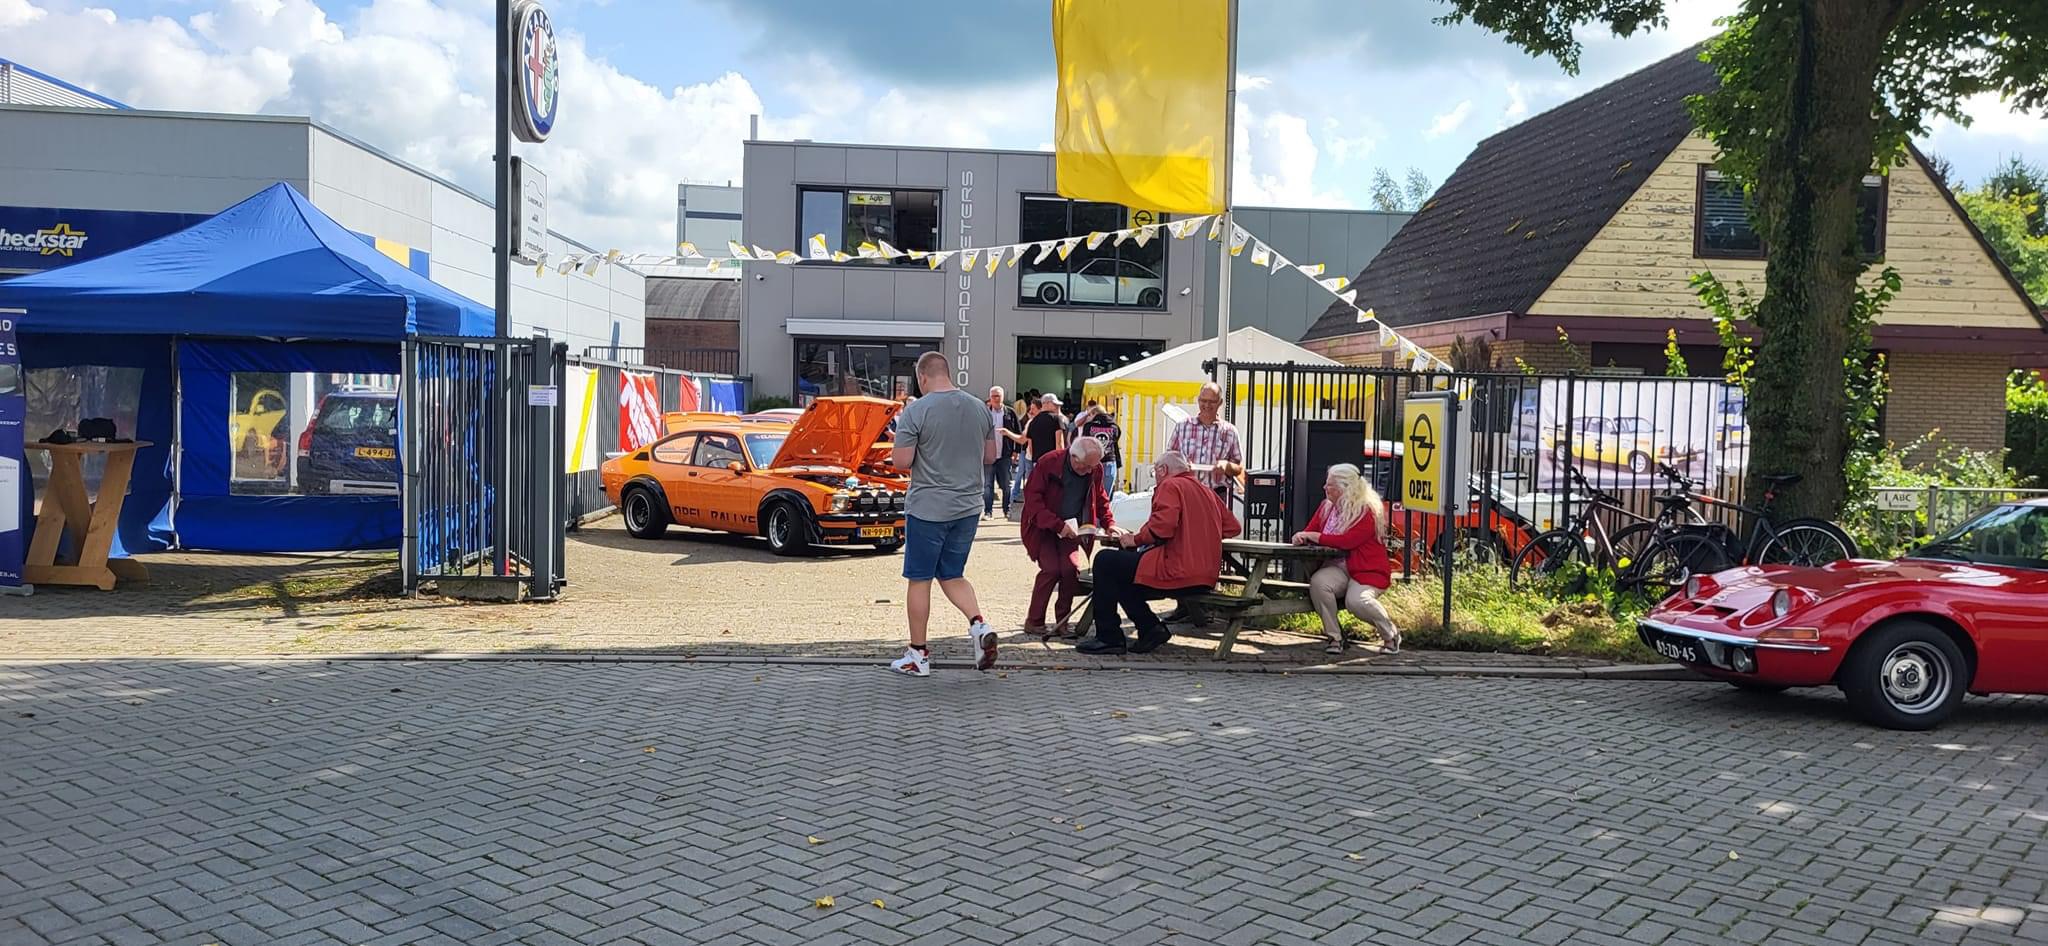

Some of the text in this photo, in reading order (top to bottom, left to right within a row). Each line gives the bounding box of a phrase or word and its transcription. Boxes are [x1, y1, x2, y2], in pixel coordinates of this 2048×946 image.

[0, 229, 89, 249] heckstar
[957, 170, 973, 387] OSCHADE ETERS
[1409, 479, 1434, 501] OPEL
[1892, 494, 1912, 502] ABC
[1250, 502, 1268, 516] 117
